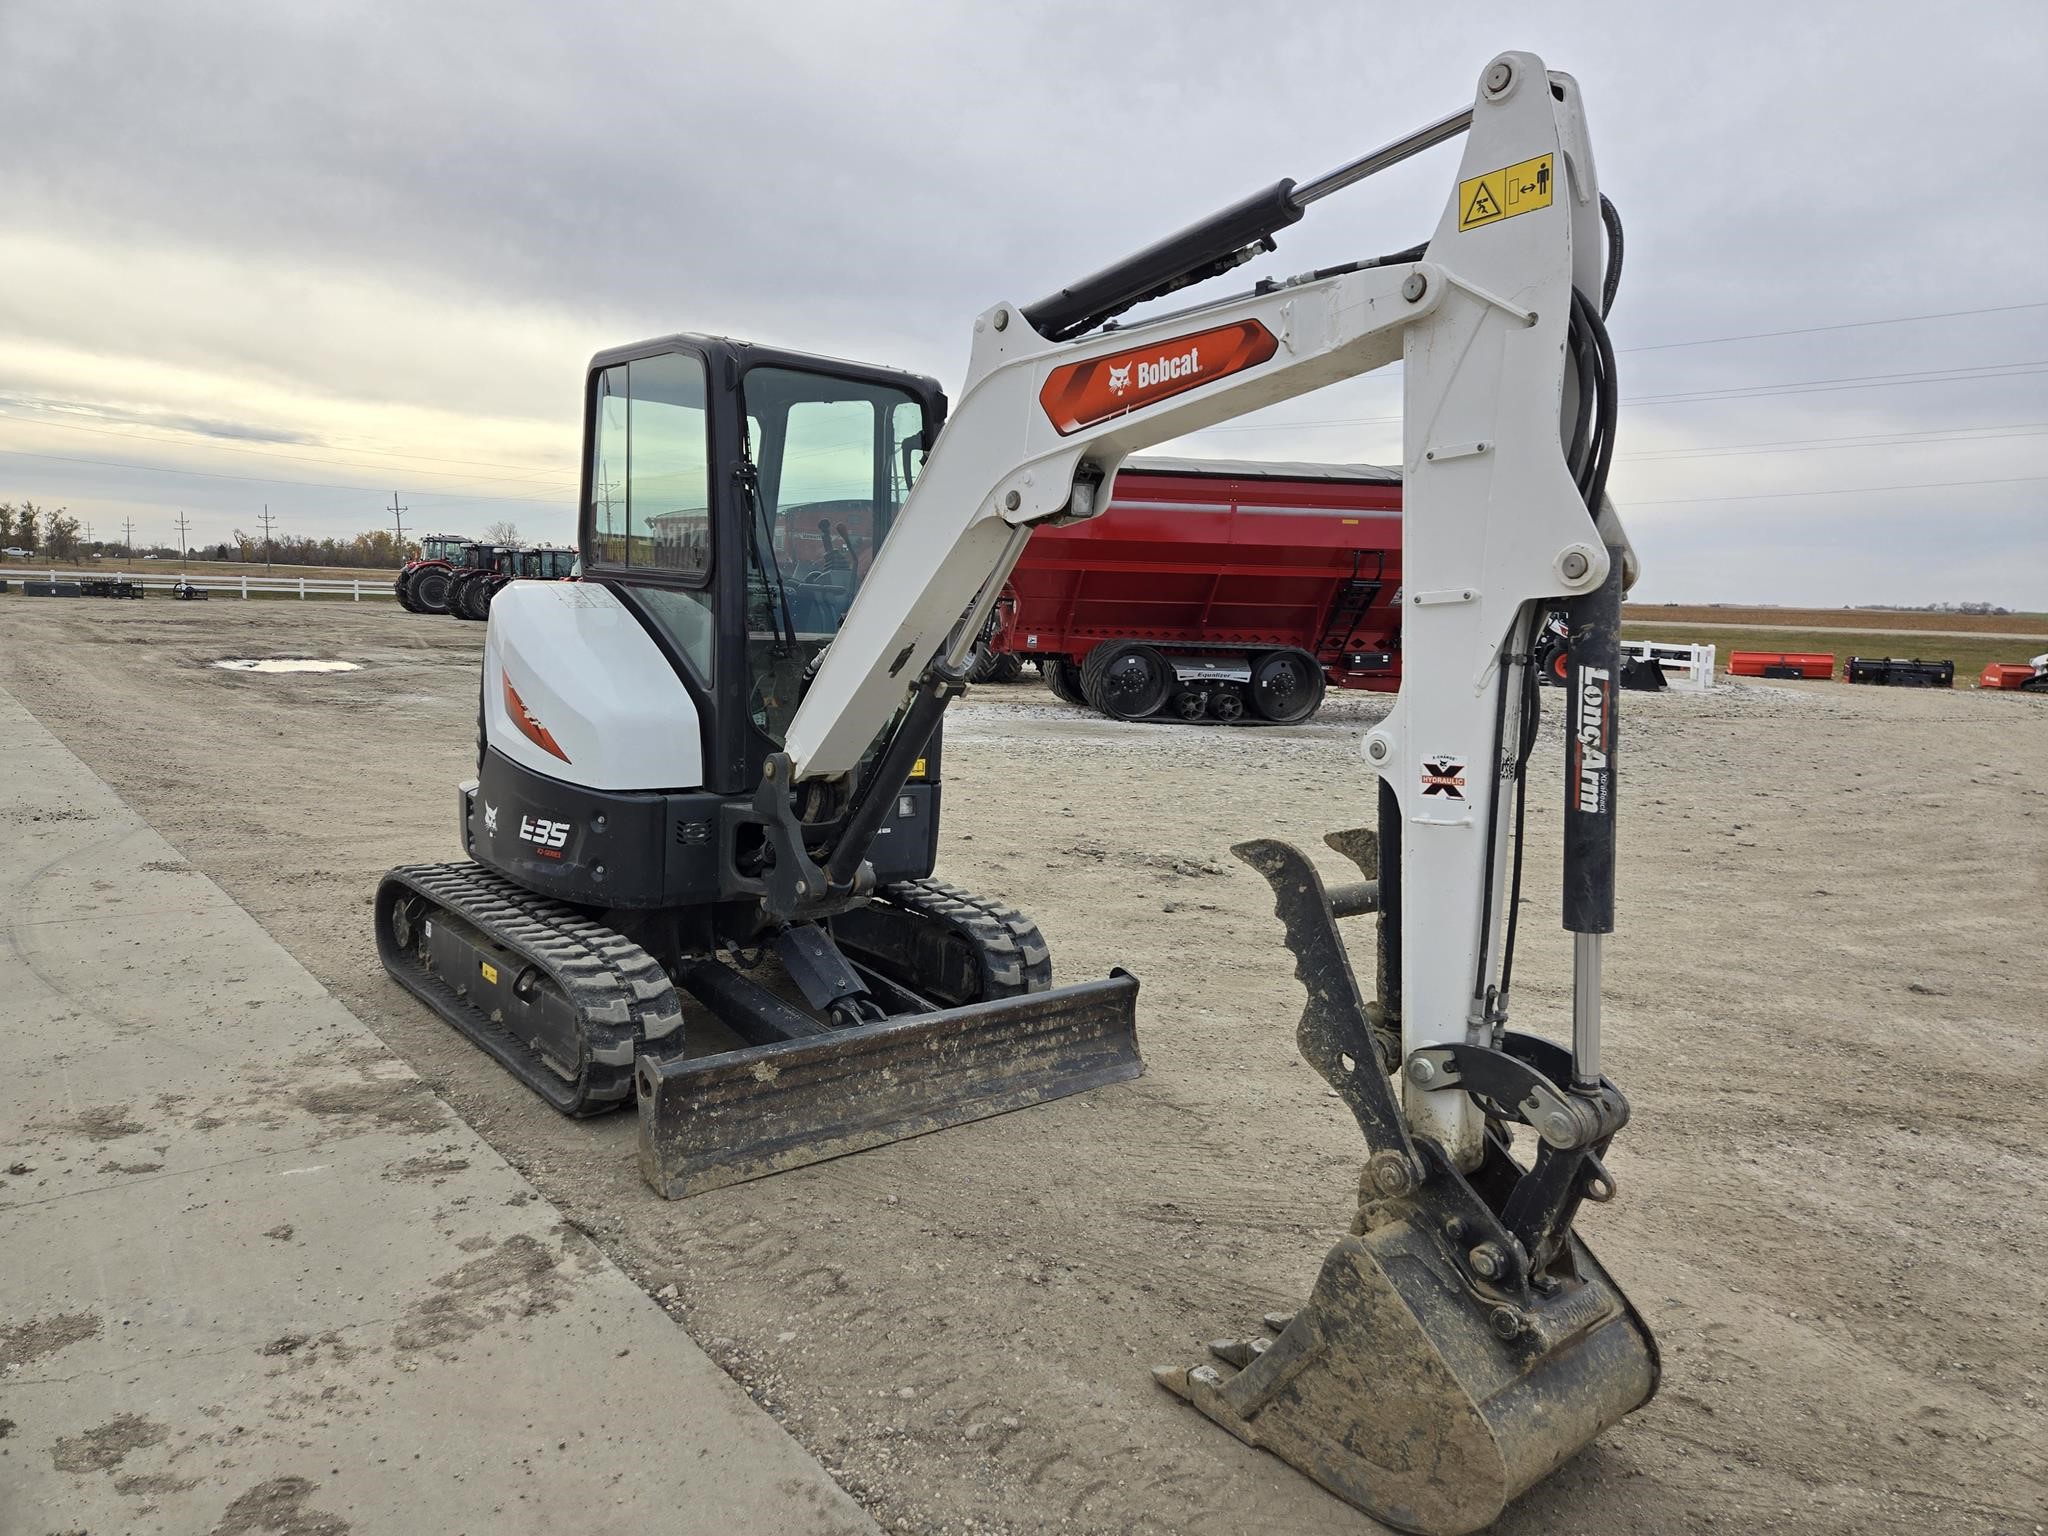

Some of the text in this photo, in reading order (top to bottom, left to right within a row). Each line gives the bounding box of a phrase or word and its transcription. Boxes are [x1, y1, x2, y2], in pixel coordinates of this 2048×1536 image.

[1137, 347, 1199, 389] Bobcat
[1577, 665, 1610, 814] LongArm
[1423, 775, 1465, 786] HYDRAULIC
[519, 815, 570, 848] E35
